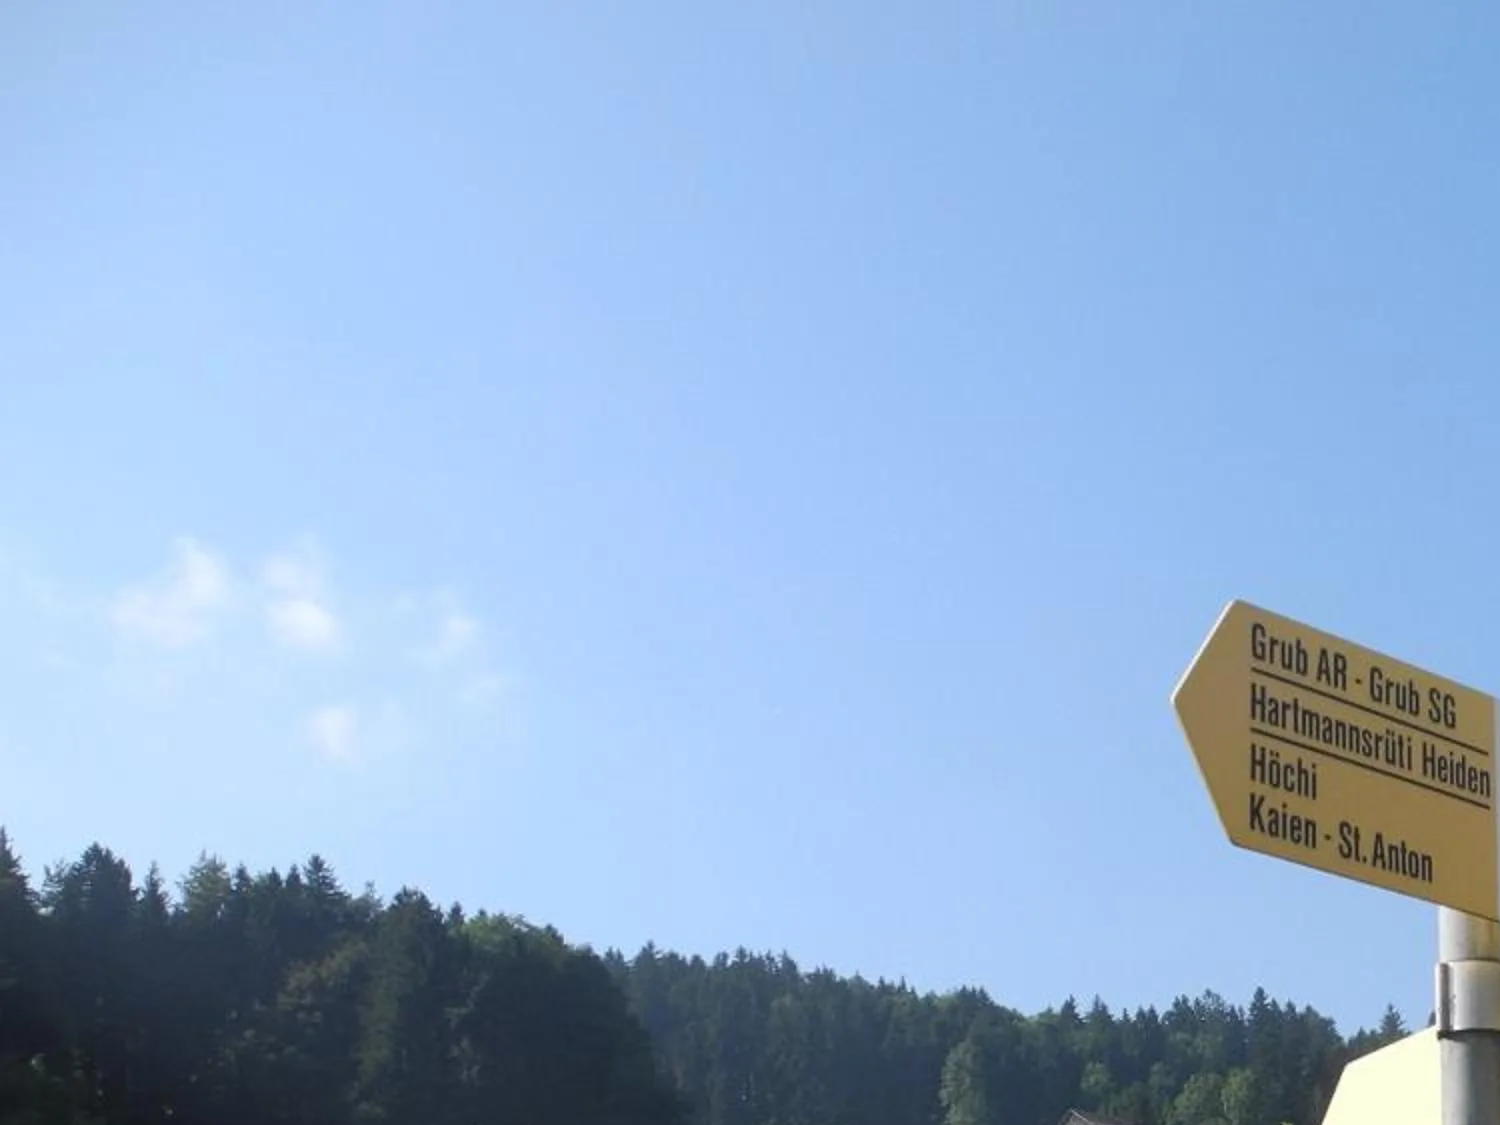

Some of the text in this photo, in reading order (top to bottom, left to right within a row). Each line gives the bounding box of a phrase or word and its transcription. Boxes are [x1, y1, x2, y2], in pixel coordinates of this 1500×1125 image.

[1251, 623, 1308, 676] Grub
[1316, 648, 1347, 690] AR
[1369, 666, 1419, 716] Grub
[1428, 687, 1456, 729] SG
[1250, 743, 1317, 800] Höchi
[1251, 682, 1490, 798] Hartmannsrüti Heiden
[1250, 792, 1317, 849] Kaien
